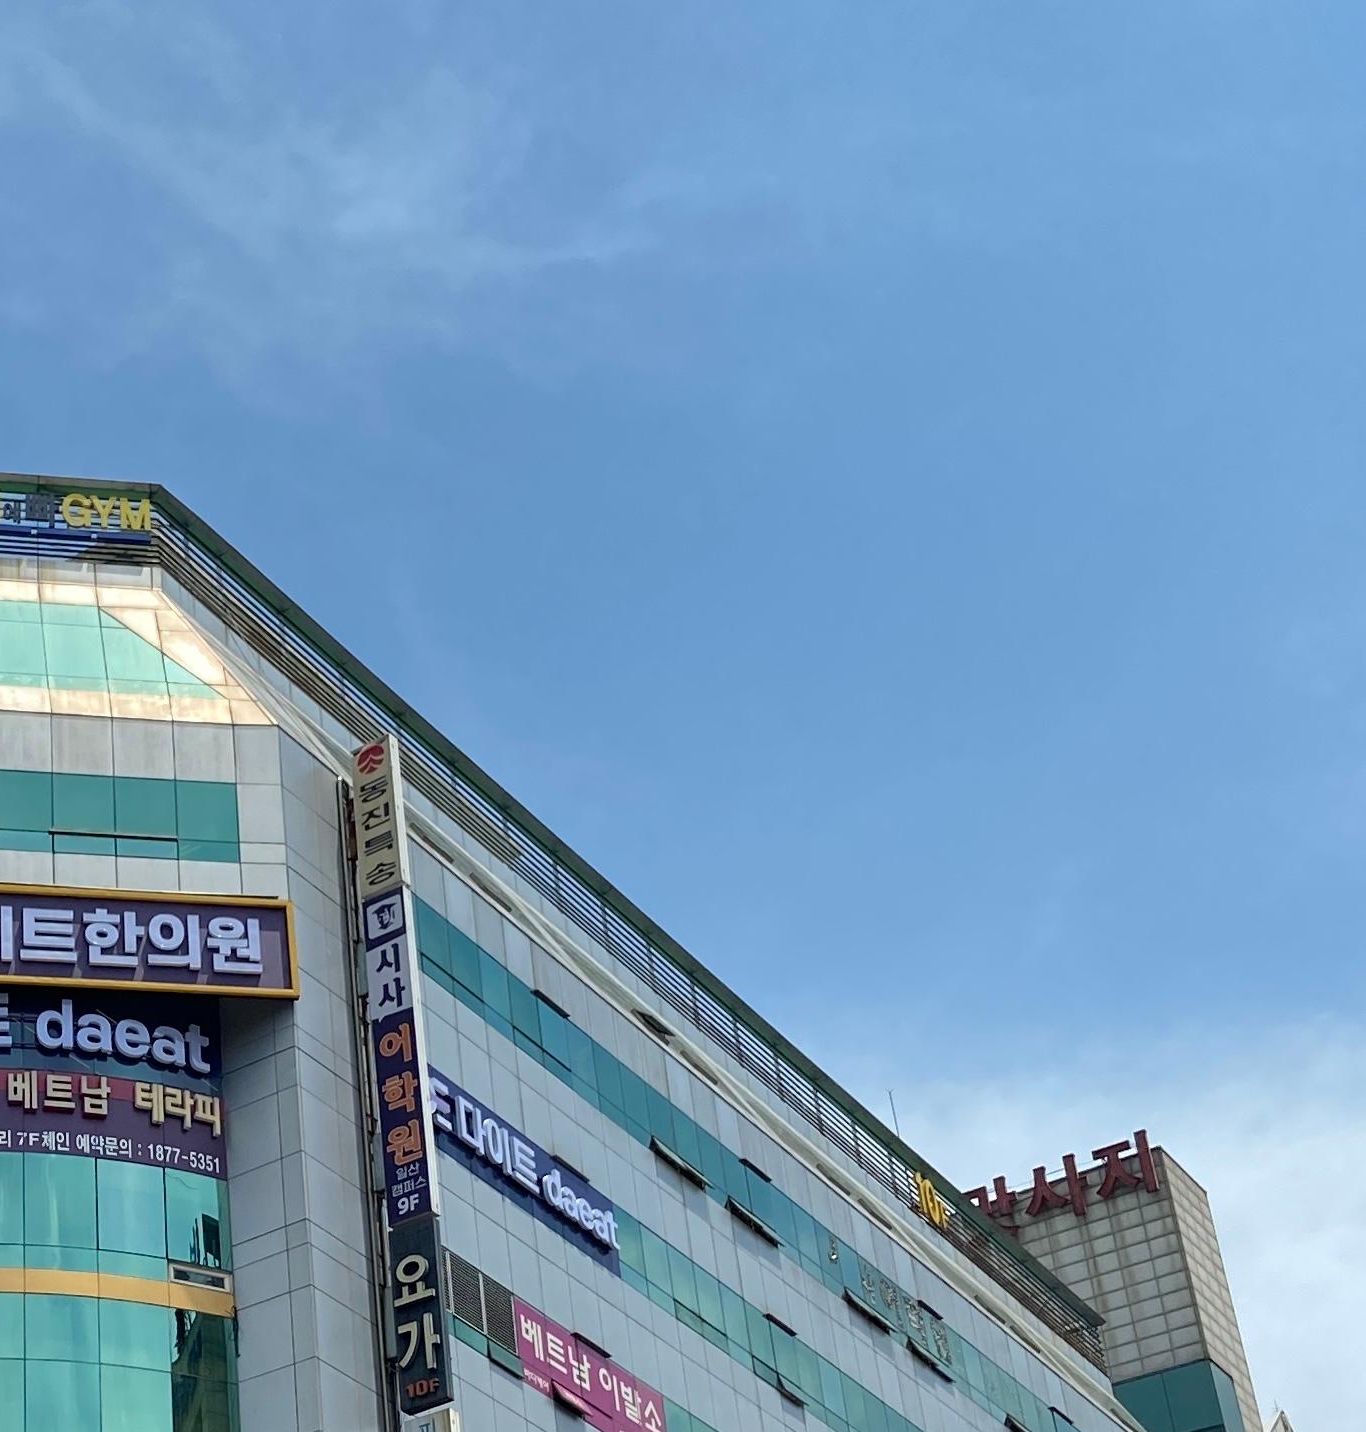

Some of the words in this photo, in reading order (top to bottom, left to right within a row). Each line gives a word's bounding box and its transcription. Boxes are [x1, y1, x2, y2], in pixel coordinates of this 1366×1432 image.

[61, 493, 152, 530] GYM
[36, 998, 212, 1074] daeat
[7, 1073, 111, 1118] 베트남
[135, 1081, 223, 1137] 테라피
[378, 1021, 424, 1166] 어학원
[75, 1134, 133, 1159] 예약문의
[146, 1143, 221, 1175] 1877-5351
[454, 1095, 539, 1195] 다이트
[542, 1168, 621, 1250] daeat
[398, 1196, 420, 1216] 9F
[394, 1255, 441, 1370] 요가
[519, 1313, 592, 1393] 베트남
[405, 1378, 441, 1399] 10F
